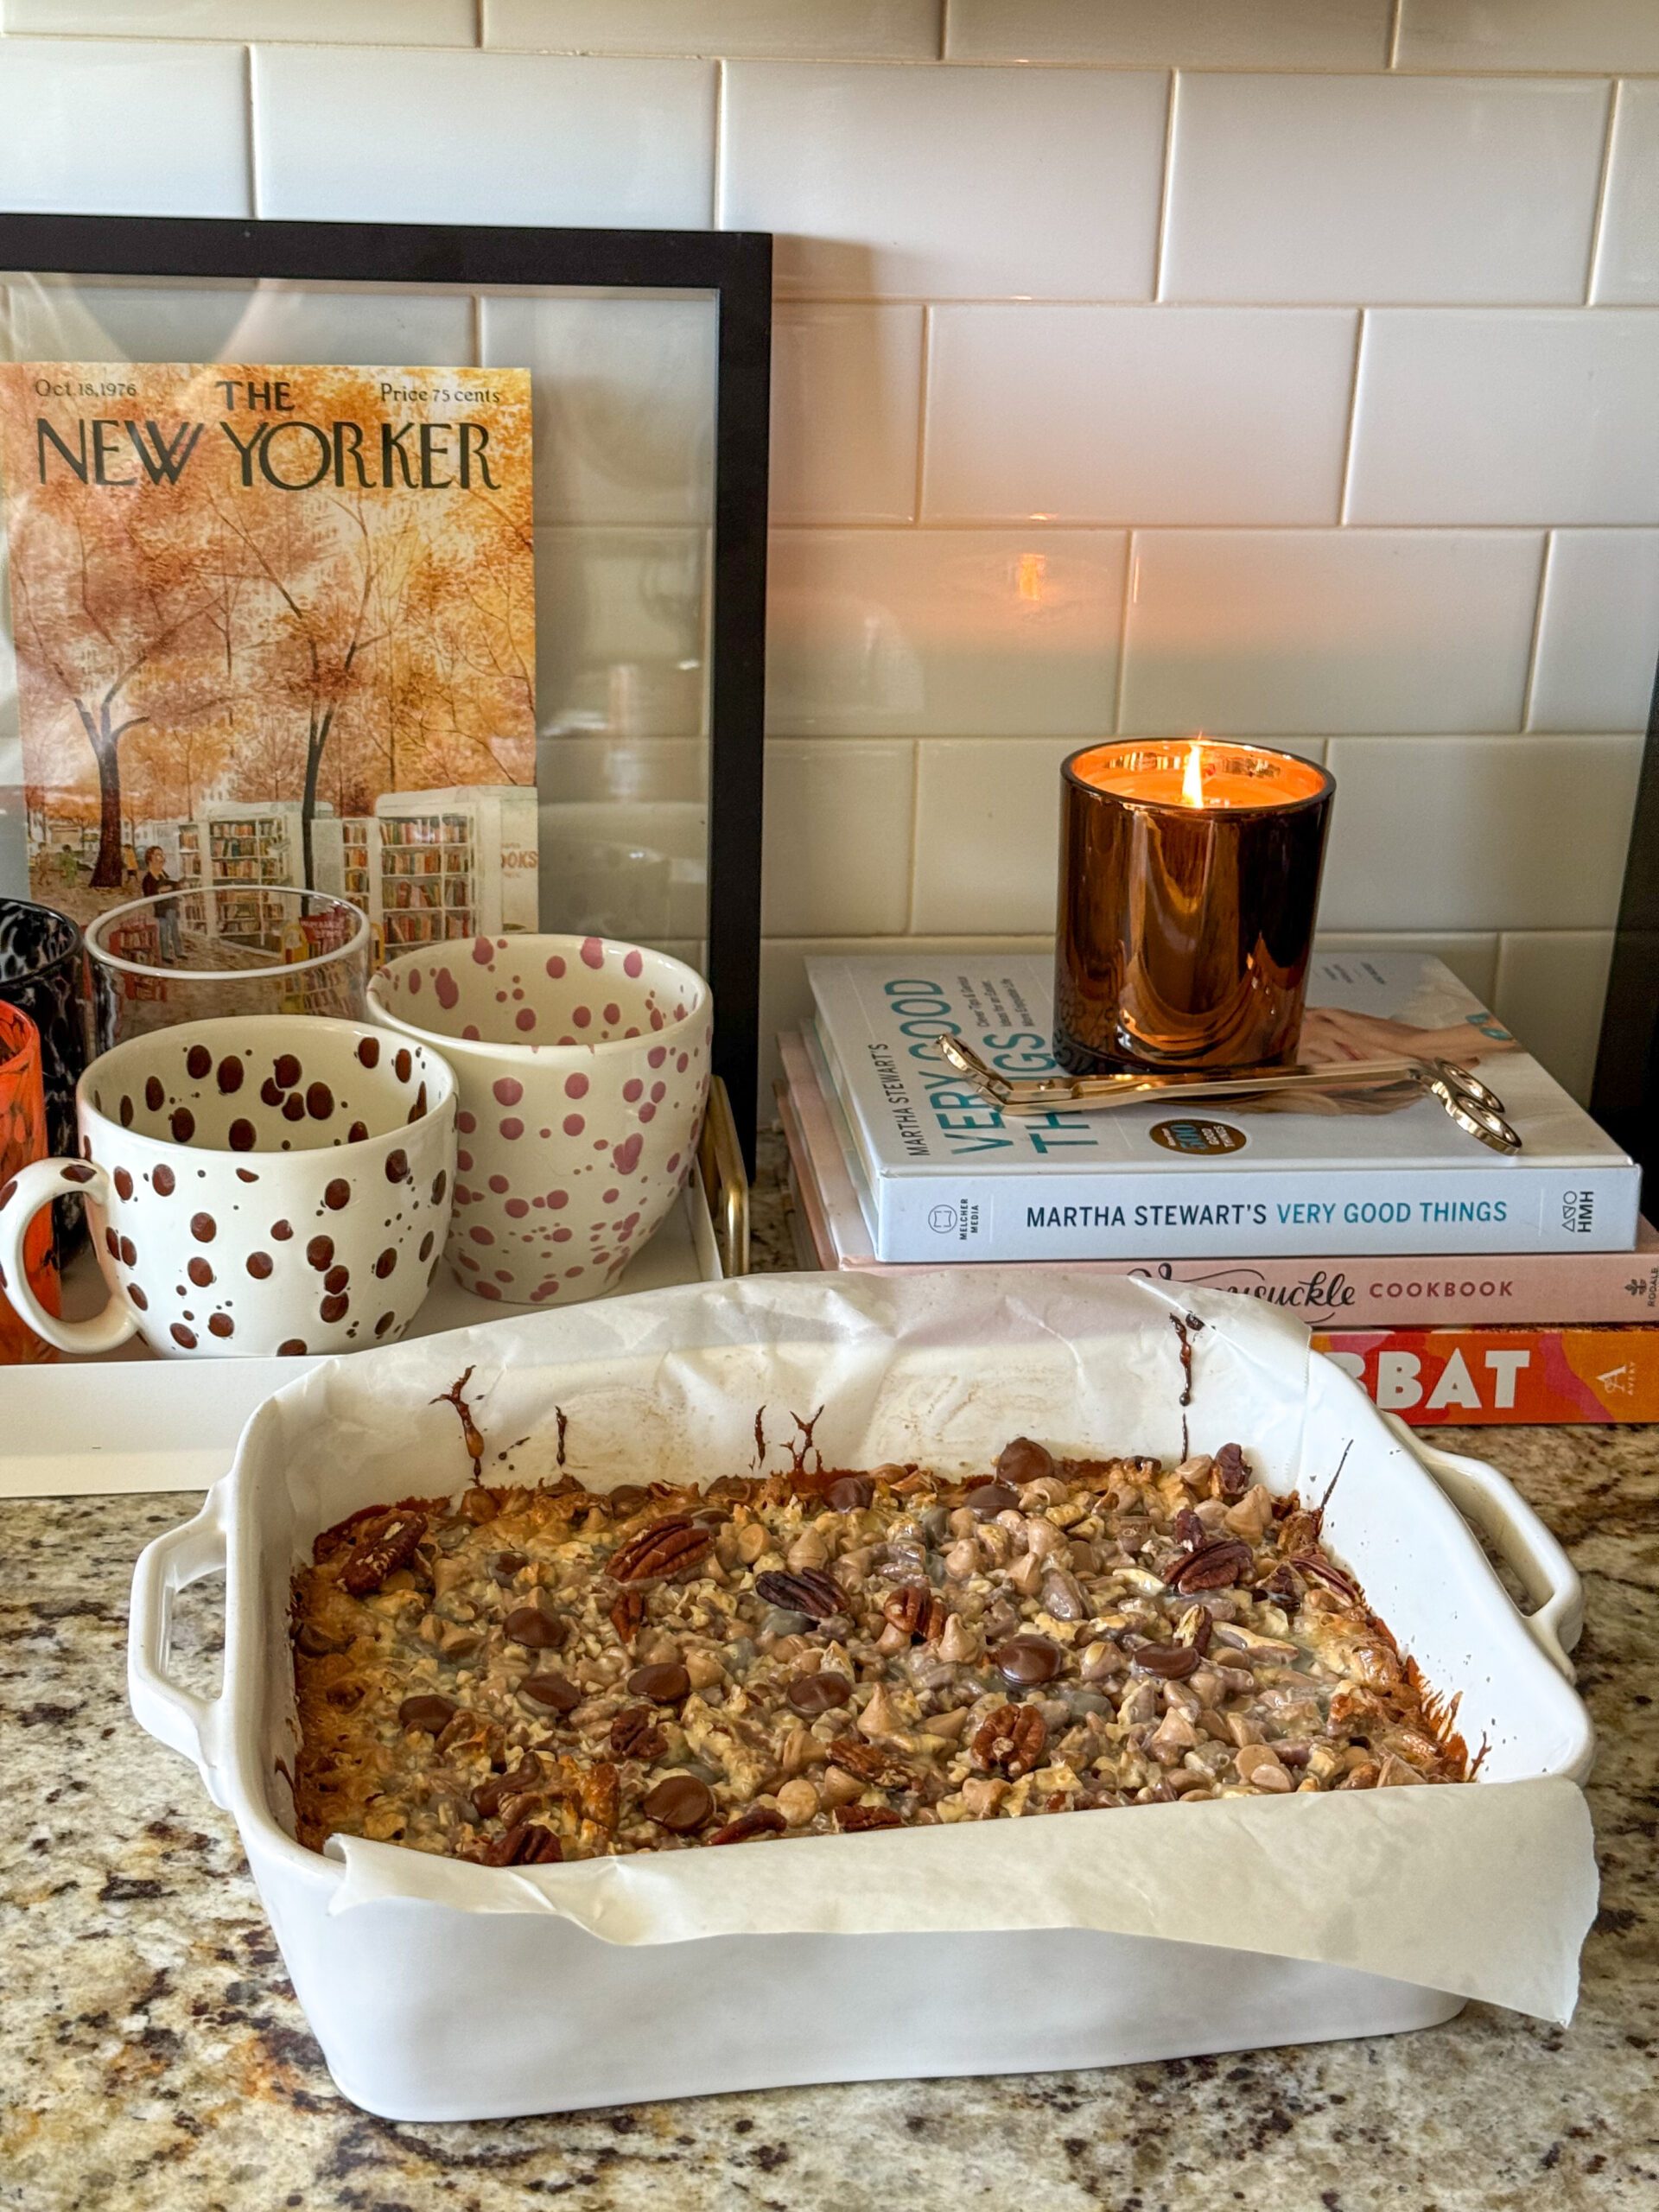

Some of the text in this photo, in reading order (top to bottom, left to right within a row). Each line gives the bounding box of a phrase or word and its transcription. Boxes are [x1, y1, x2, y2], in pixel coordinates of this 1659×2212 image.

[217, 380, 295, 411] THE
[381, 383, 500, 404] Price 75 cents
[37, 417, 501, 491] NEW YORKER
[868, 1043, 931, 1156] MARTHA STEWART'S
[918, 1071, 1014, 1155] VERY
[982, 1033, 1099, 1154] THGS
[959, 1198, 969, 1241] MELCHER
[970, 1205, 979, 1234] MEDIA
[1027, 1201, 1508, 1227] MARTHA STEWART'S VERY GOOD THINGS
[1577, 1191, 1595, 1233] HMH
[1369, 1281, 1513, 1298] COOKBOOK
